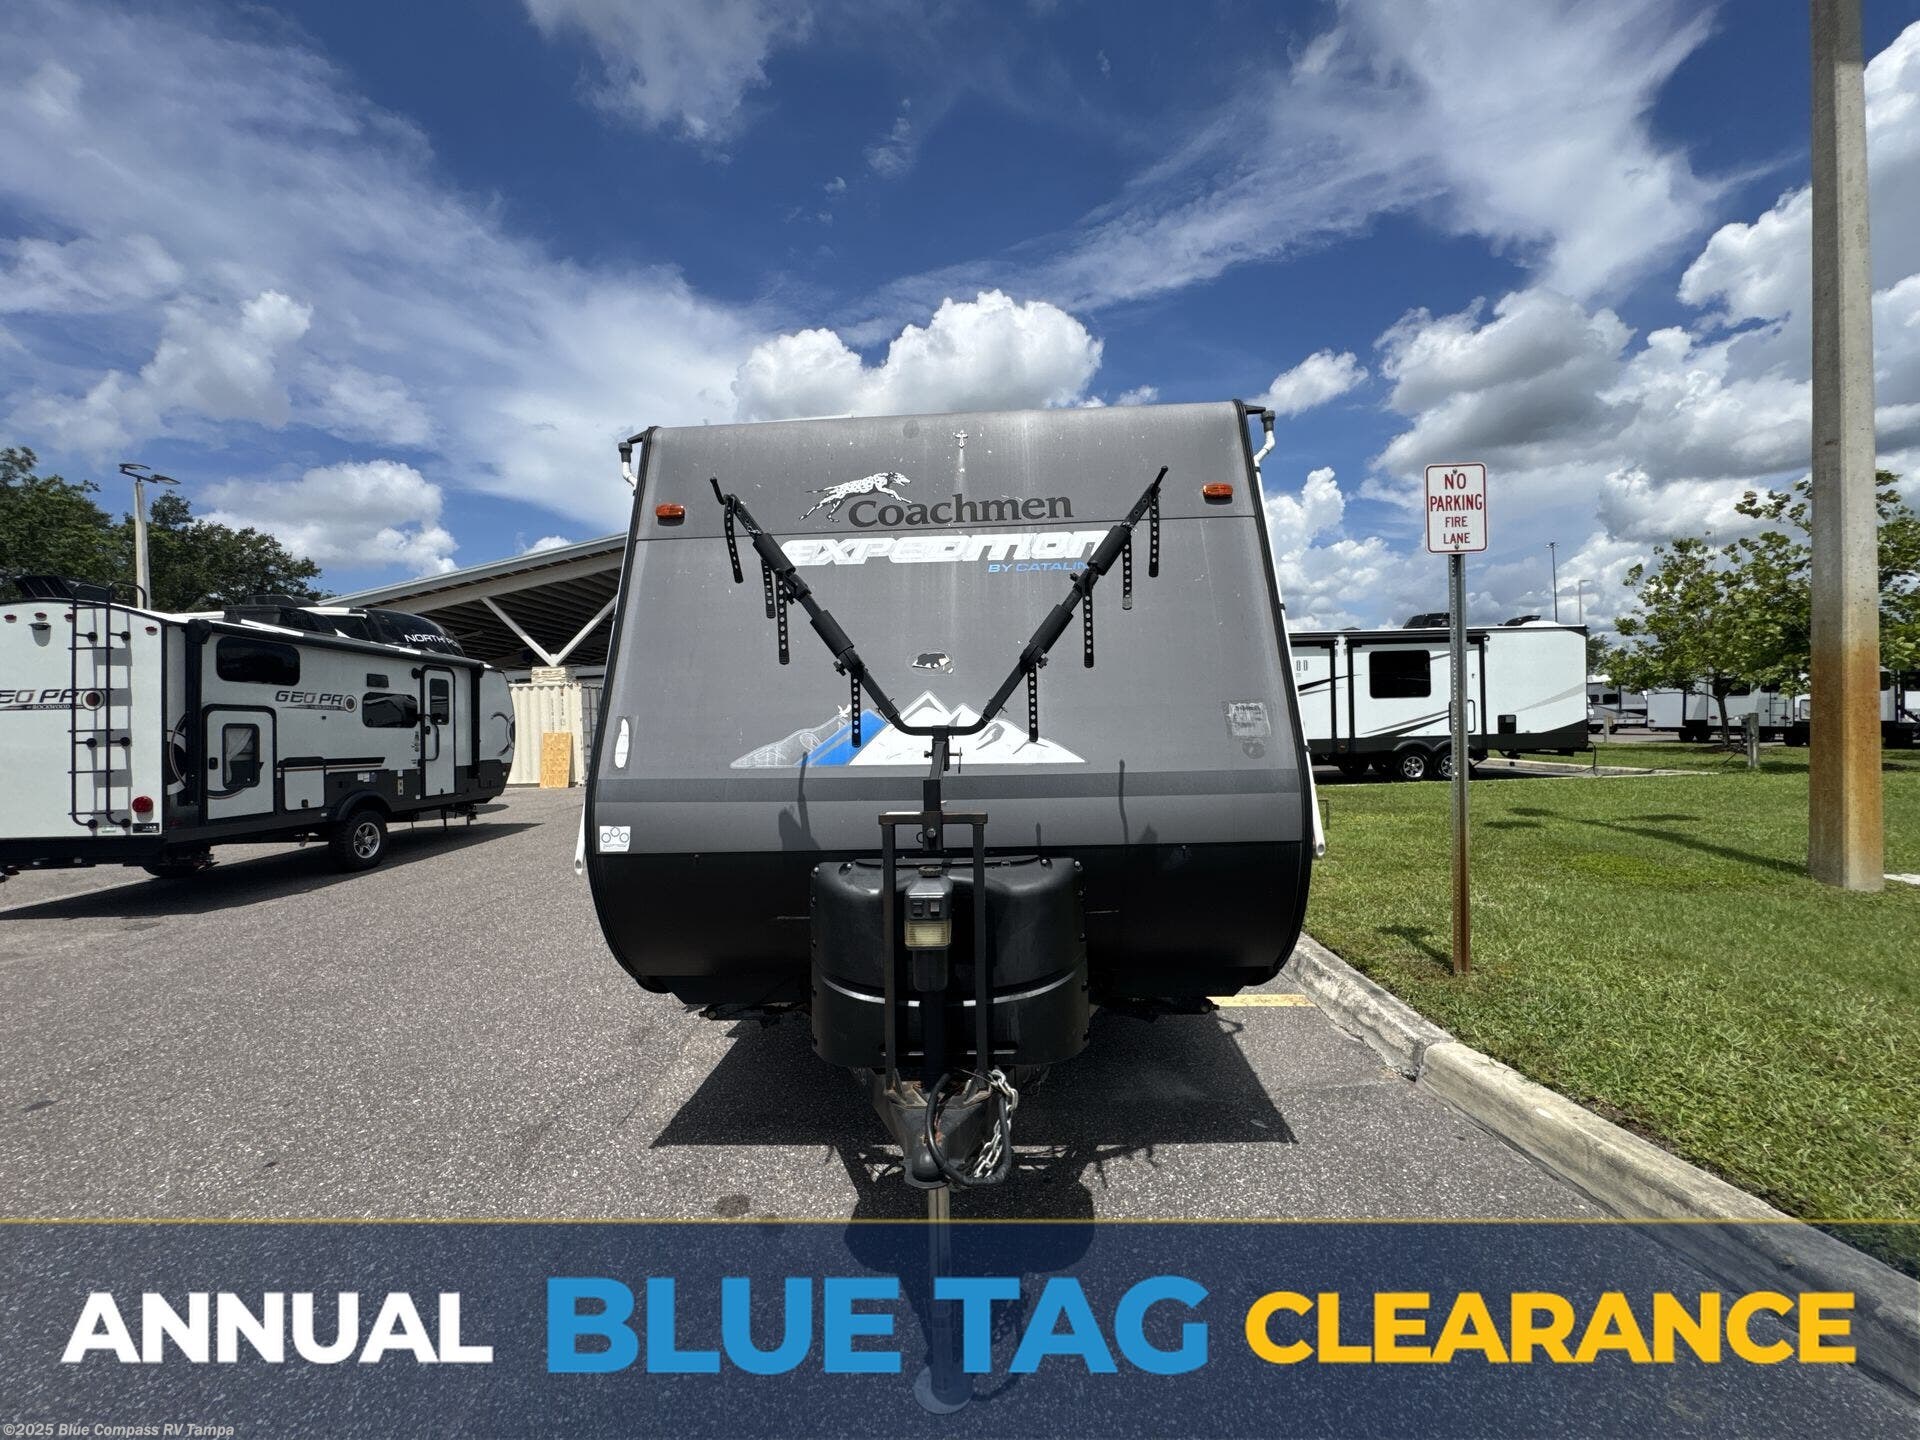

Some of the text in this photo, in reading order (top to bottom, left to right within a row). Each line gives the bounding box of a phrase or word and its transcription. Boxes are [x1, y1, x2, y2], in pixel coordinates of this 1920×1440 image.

[1444, 473, 1467, 490] NO
[1430, 494, 1483, 512] PARKING
[848, 493, 1074, 528] Coachmen
[1445, 516, 1468, 528] FIRE
[1443, 532, 1471, 545] LANE
[988, 560, 1089, 573] BY CATALIN
[404, 634, 446, 643] NORTH
[0, 689, 36, 704] EO
[275, 690, 317, 704] GEO
